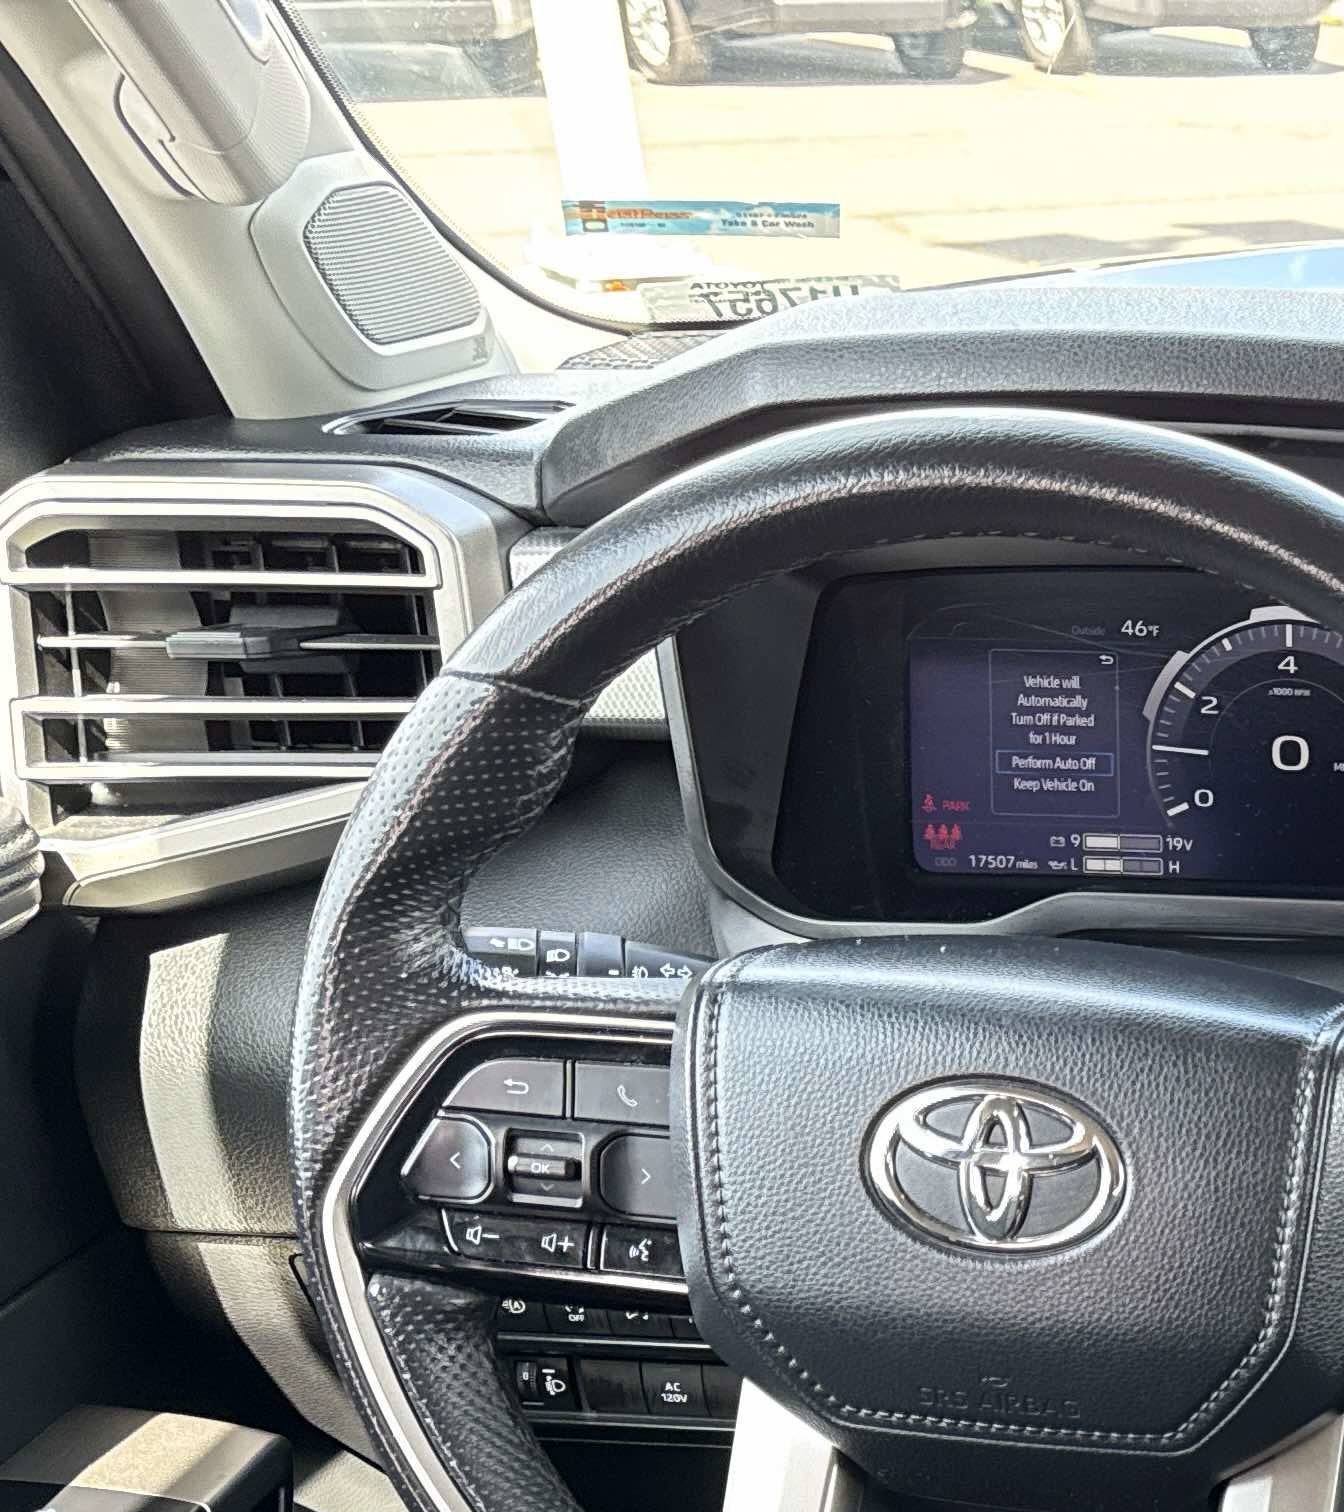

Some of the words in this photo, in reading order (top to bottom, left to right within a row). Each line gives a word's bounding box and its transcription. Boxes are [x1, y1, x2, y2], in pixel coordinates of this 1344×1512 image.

[1277, 656, 1298, 673] 4
[1023, 675, 1060, 689] Vehicle
[1062, 676, 1080, 689] will
[1017, 694, 1088, 710] Automatically
[1200, 697, 1219, 714] 2
[1012, 713, 1034, 726] Turn
[1035, 713, 1051, 727] Off
[1052, 713, 1058, 726] if
[1059, 714, 1094, 728] Parked
[1029, 731, 1043, 745] for
[1052, 732, 1076, 745] Hour
[1271, 735, 1310, 771] 0
[1012, 756, 1053, 769] Perform
[1056, 757, 1077, 770] Auto
[1079, 757, 1096, 771] Off
[1014, 778, 1040, 793] Keep
[1042, 779, 1077, 792] Vehicle
[1079, 780, 1095, 792] On
[1194, 789, 1214, 807] 0
[1071, 835, 1081, 847] 9
[968, 856, 1015, 868] 17507
[1016, 860, 1038, 870] miles
[1071, 859, 1078, 871] L
[1169, 862, 1180, 873] H
[531, 1162, 550, 1174] OK
[665, 1382, 681, 1392] AC
[661, 1392, 688, 1403] 120V
